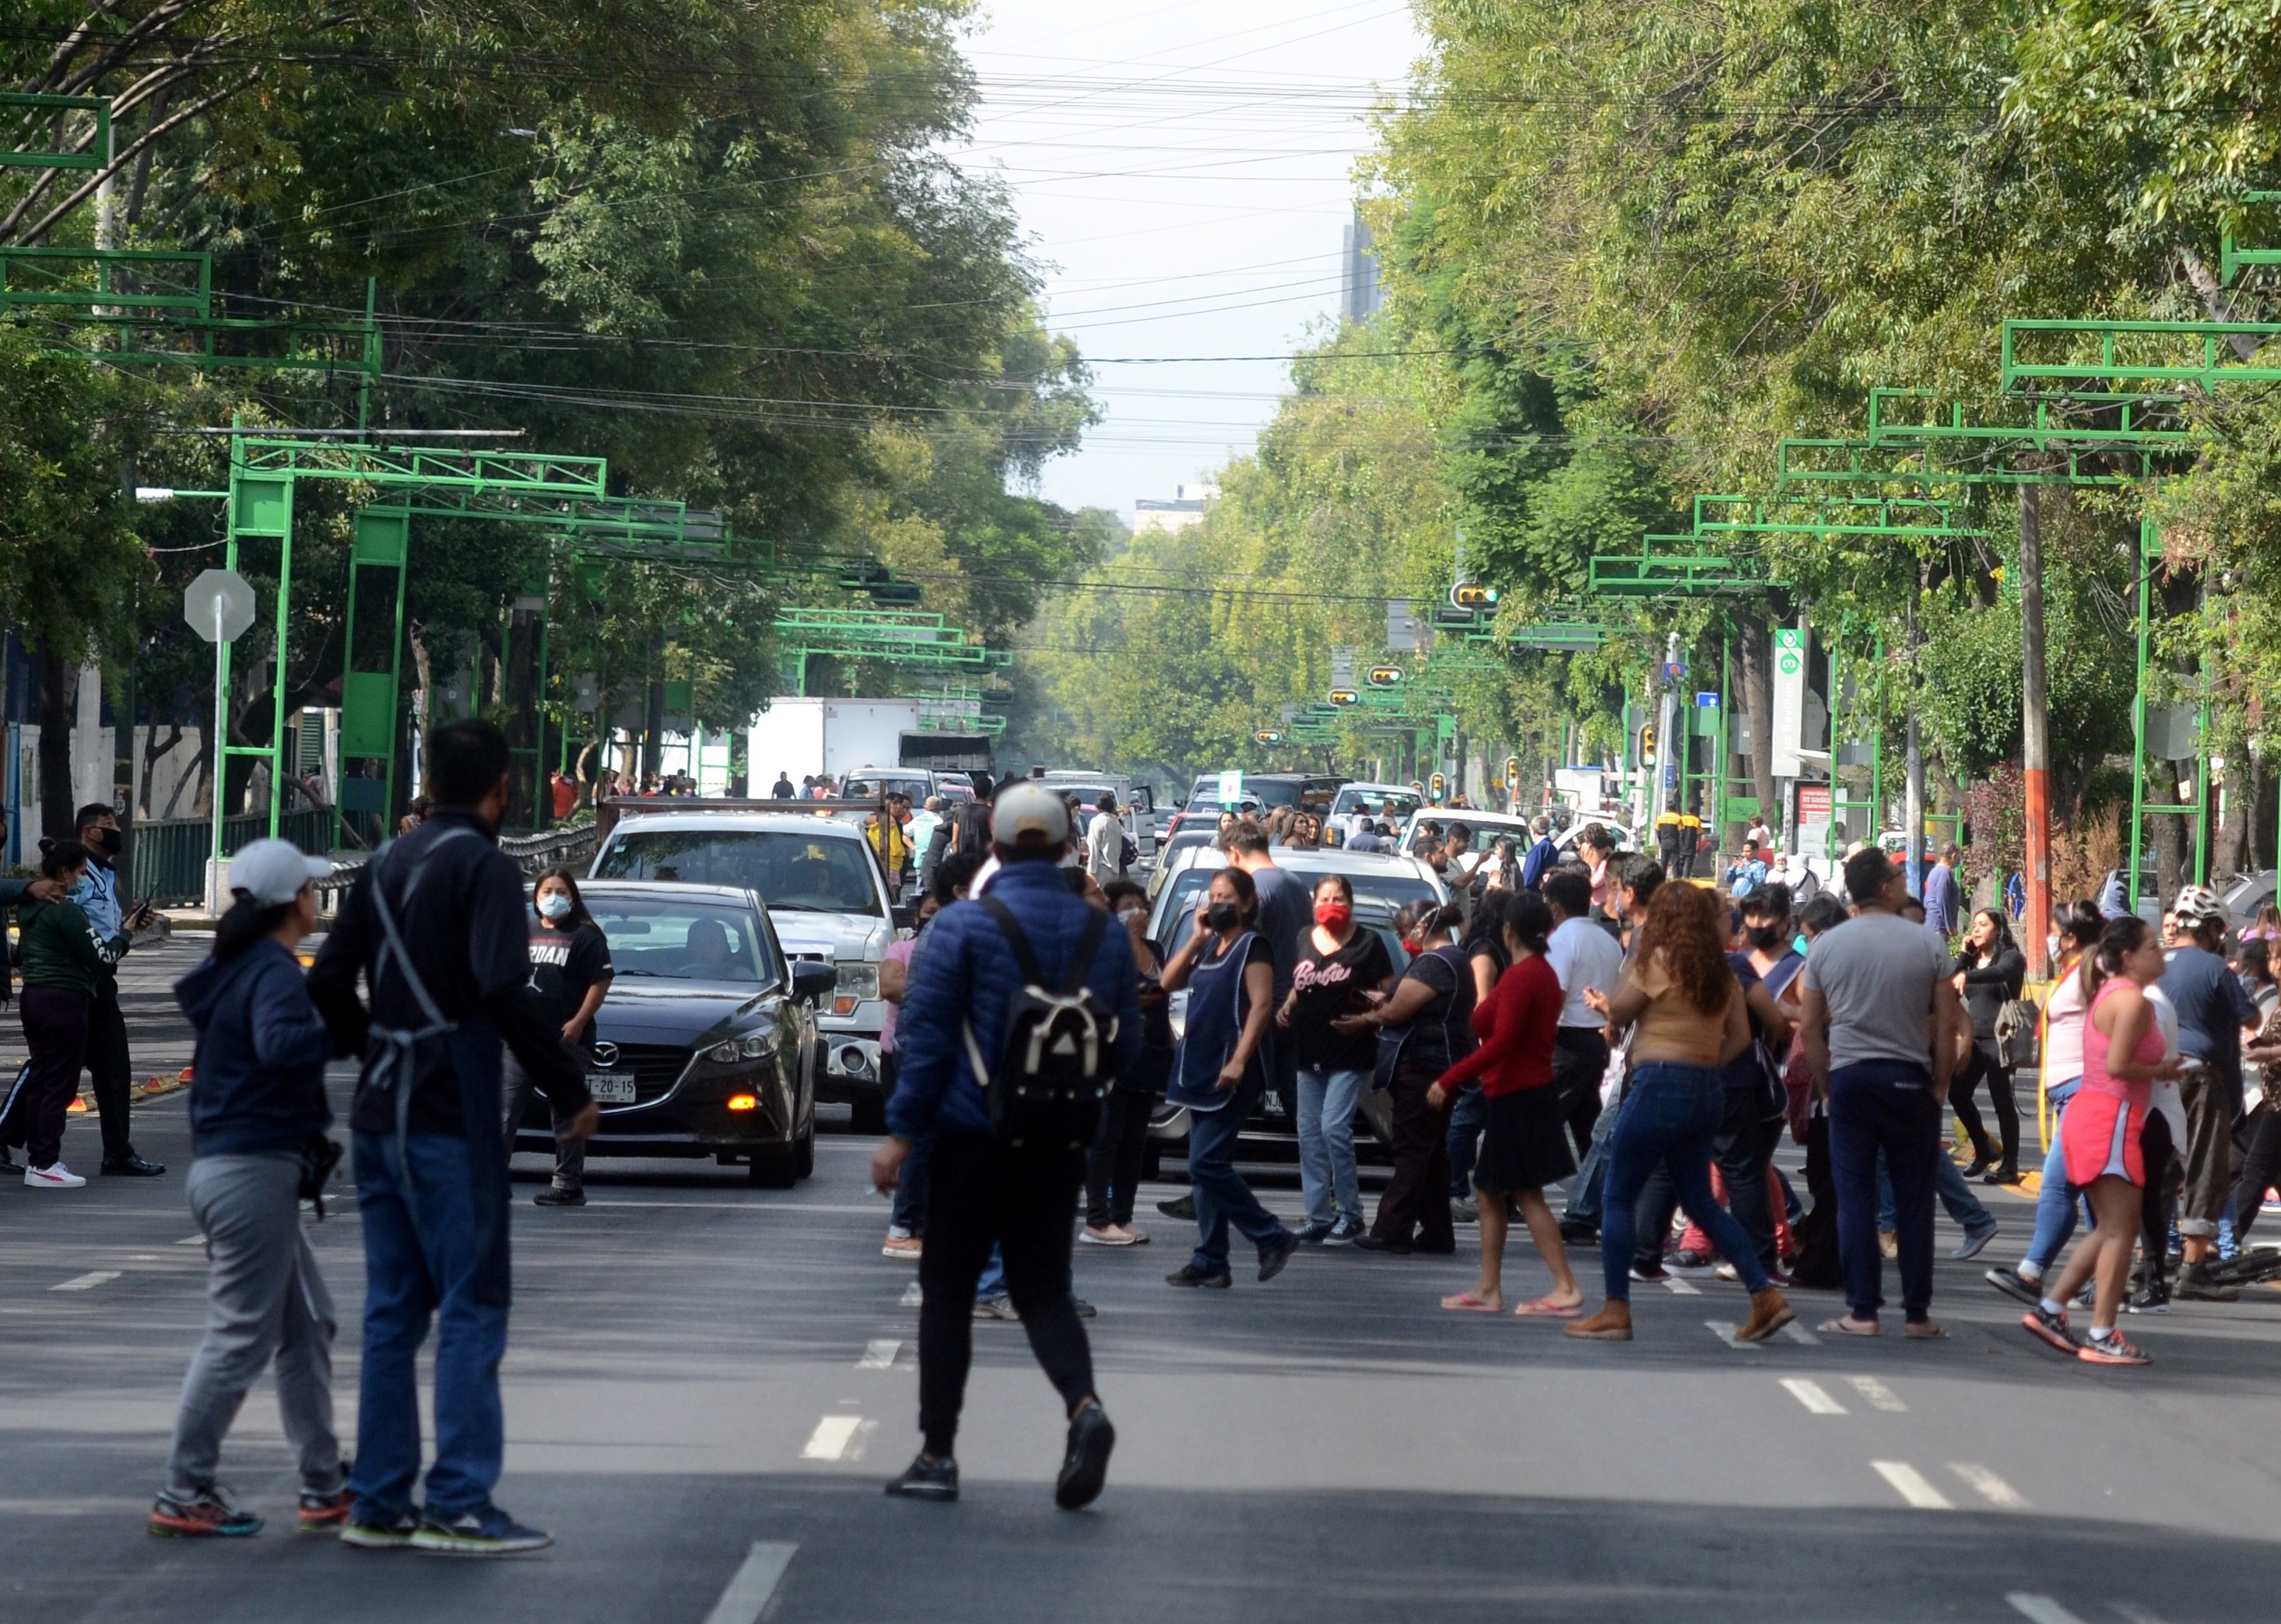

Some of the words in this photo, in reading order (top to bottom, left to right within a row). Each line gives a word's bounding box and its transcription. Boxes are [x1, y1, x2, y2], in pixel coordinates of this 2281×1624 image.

[528, 945, 570, 967] RDAN
[1293, 959, 1352, 991] Barbie
[588, 1079, 634, 1094] T-20-15
